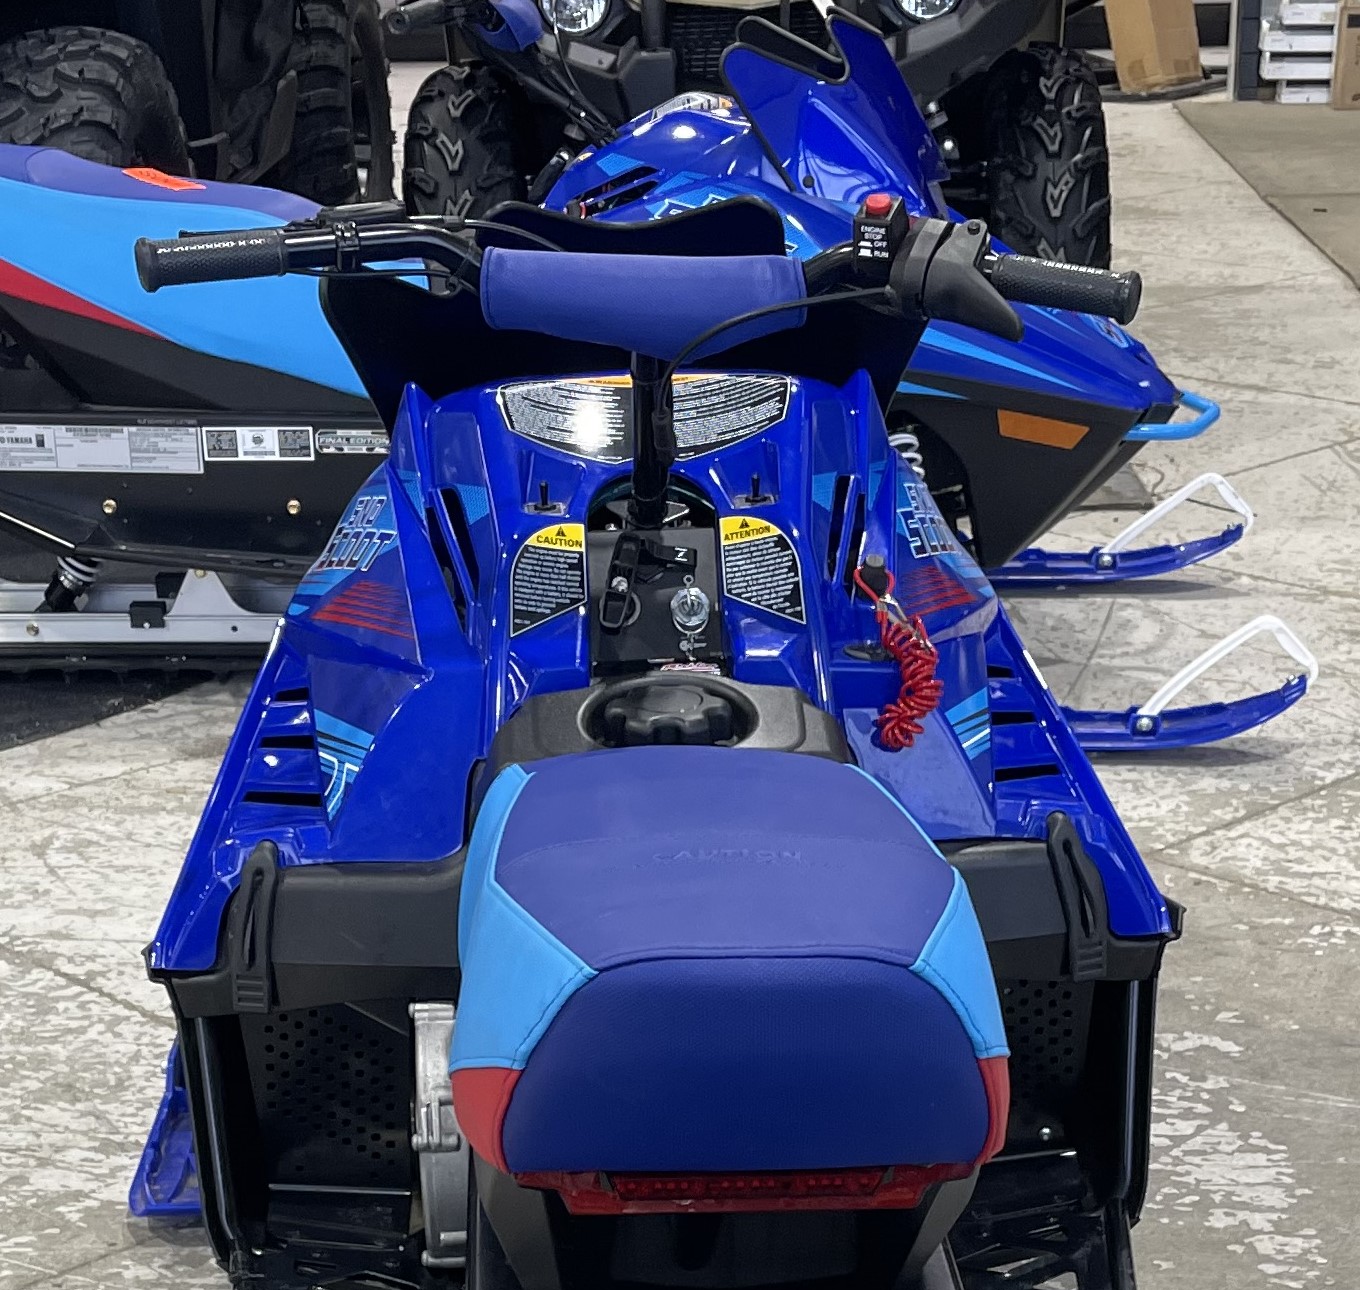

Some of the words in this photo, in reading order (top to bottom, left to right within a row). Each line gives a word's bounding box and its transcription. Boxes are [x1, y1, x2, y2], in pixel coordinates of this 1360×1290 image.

[861, 226, 885, 234] ENGINE
[6, 436, 33, 444] YAMAHA
[319, 436, 347, 444] FINAL
[349, 437, 390, 446] EDITION
[723, 525, 771, 541] ATTENTION
[536, 534, 583, 548] CAUTION
[652, 848, 802, 864] CAUTION
